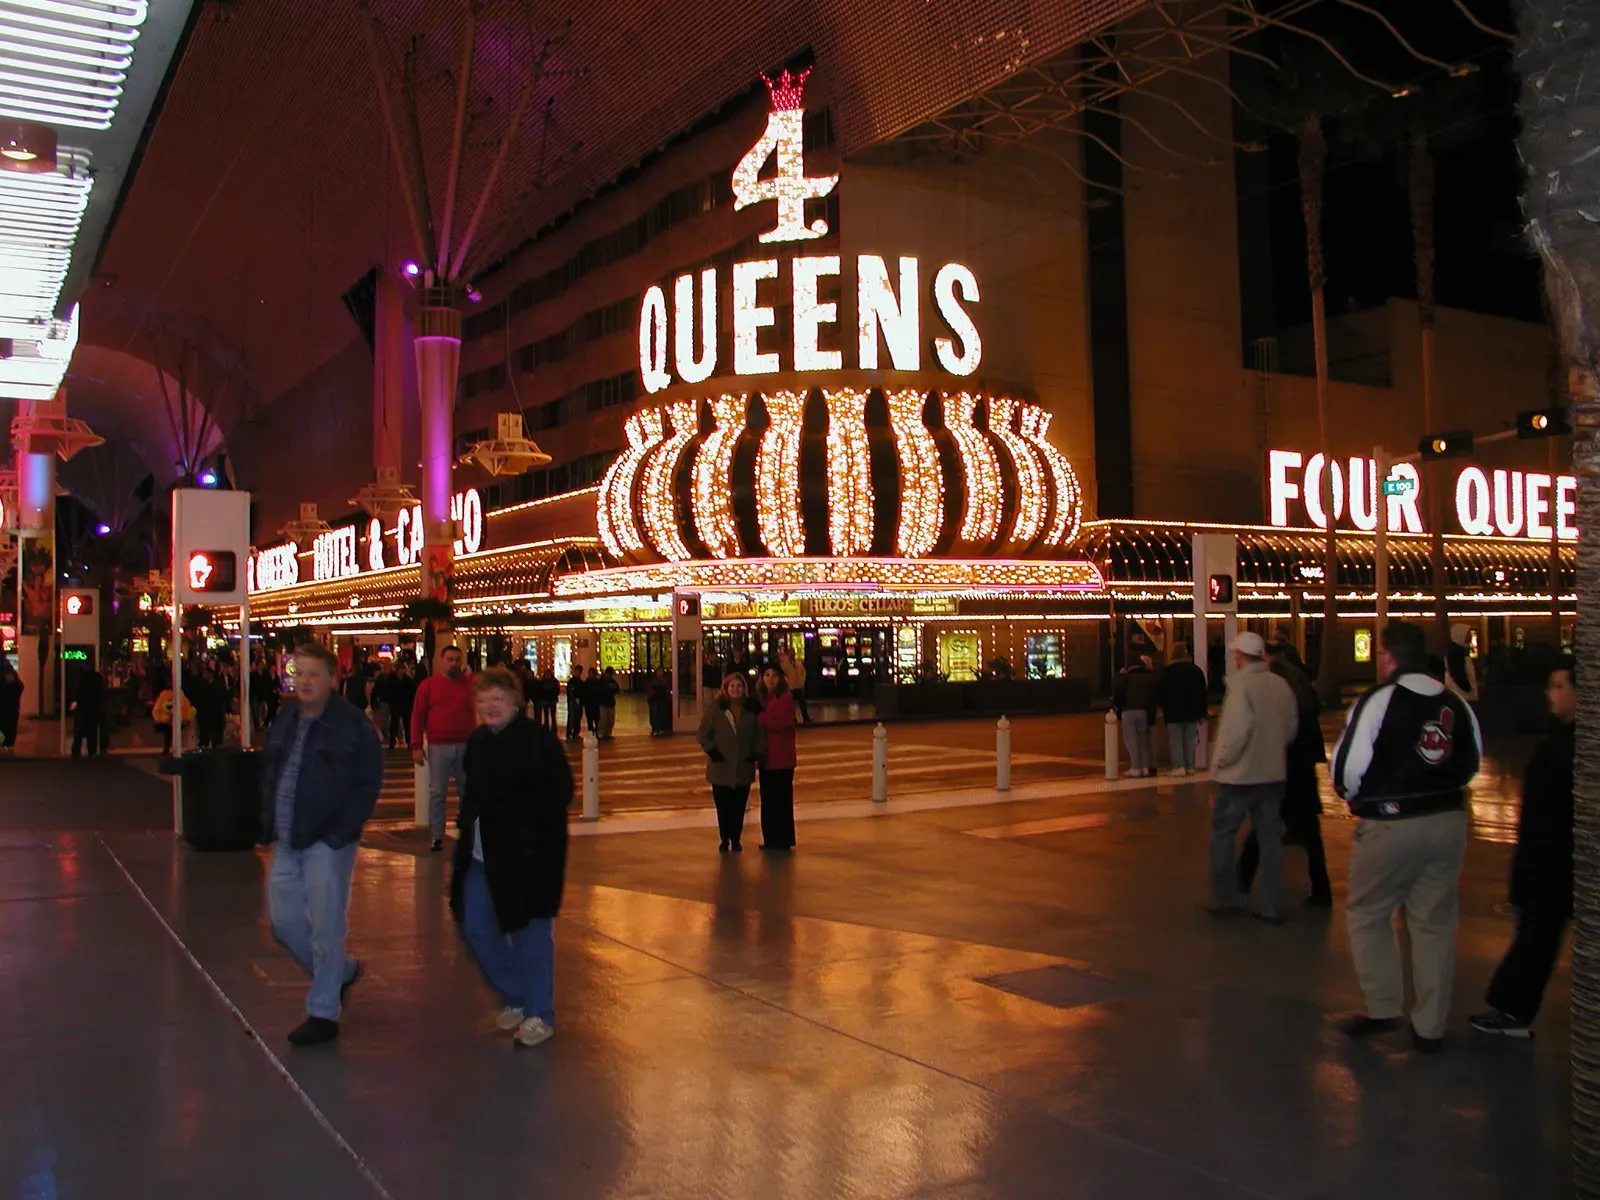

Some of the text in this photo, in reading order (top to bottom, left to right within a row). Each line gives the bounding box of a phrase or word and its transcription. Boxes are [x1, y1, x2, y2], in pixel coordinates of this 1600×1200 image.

[731, 108, 839, 243] 4
[639, 255, 982, 394] QUEENS
[1269, 450, 1579, 540] FOUR QUEE
[1396, 482, 1412, 491] 100
[313, 524, 360, 581] HOTEL
[369, 518, 385, 571] &
[858, 598, 907, 612] CELLAR
